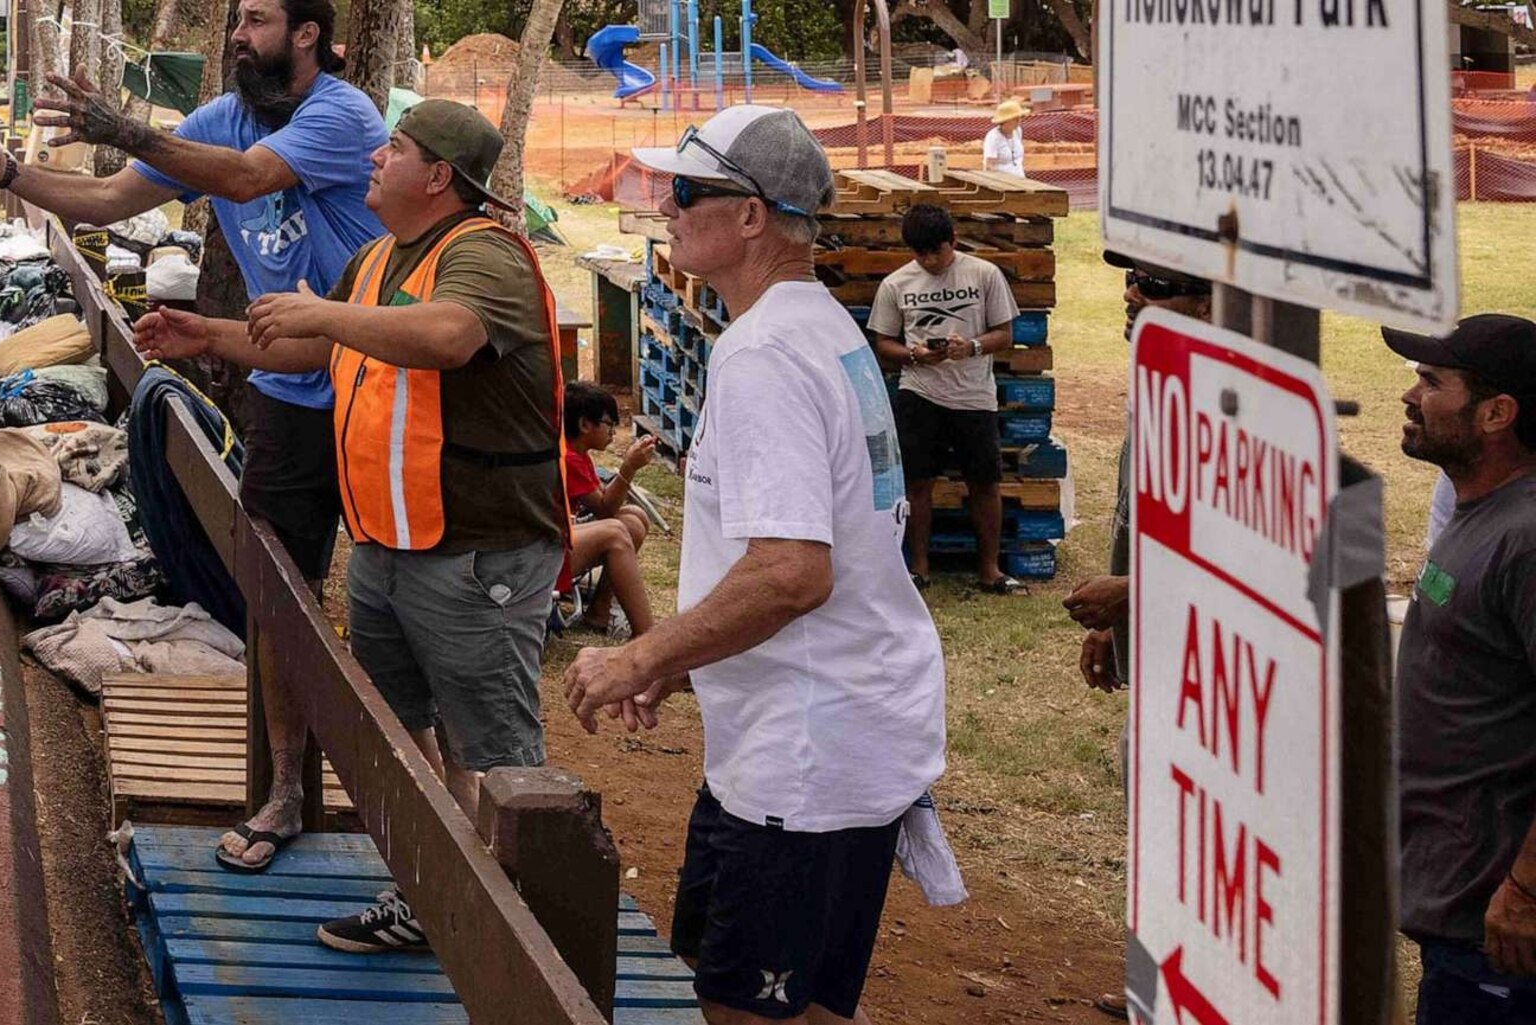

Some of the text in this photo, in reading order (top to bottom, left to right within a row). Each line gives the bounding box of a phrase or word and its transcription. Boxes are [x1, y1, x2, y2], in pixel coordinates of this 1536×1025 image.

[1177, 94, 1302, 147] MCC Section
[1197, 148, 1273, 200] 13.04.47
[904, 286, 979, 307] Reebok
[1139, 364, 1314, 566] NO PARKING
[1176, 604, 1277, 795] ANY
[1171, 763, 1281, 1002] TIME
